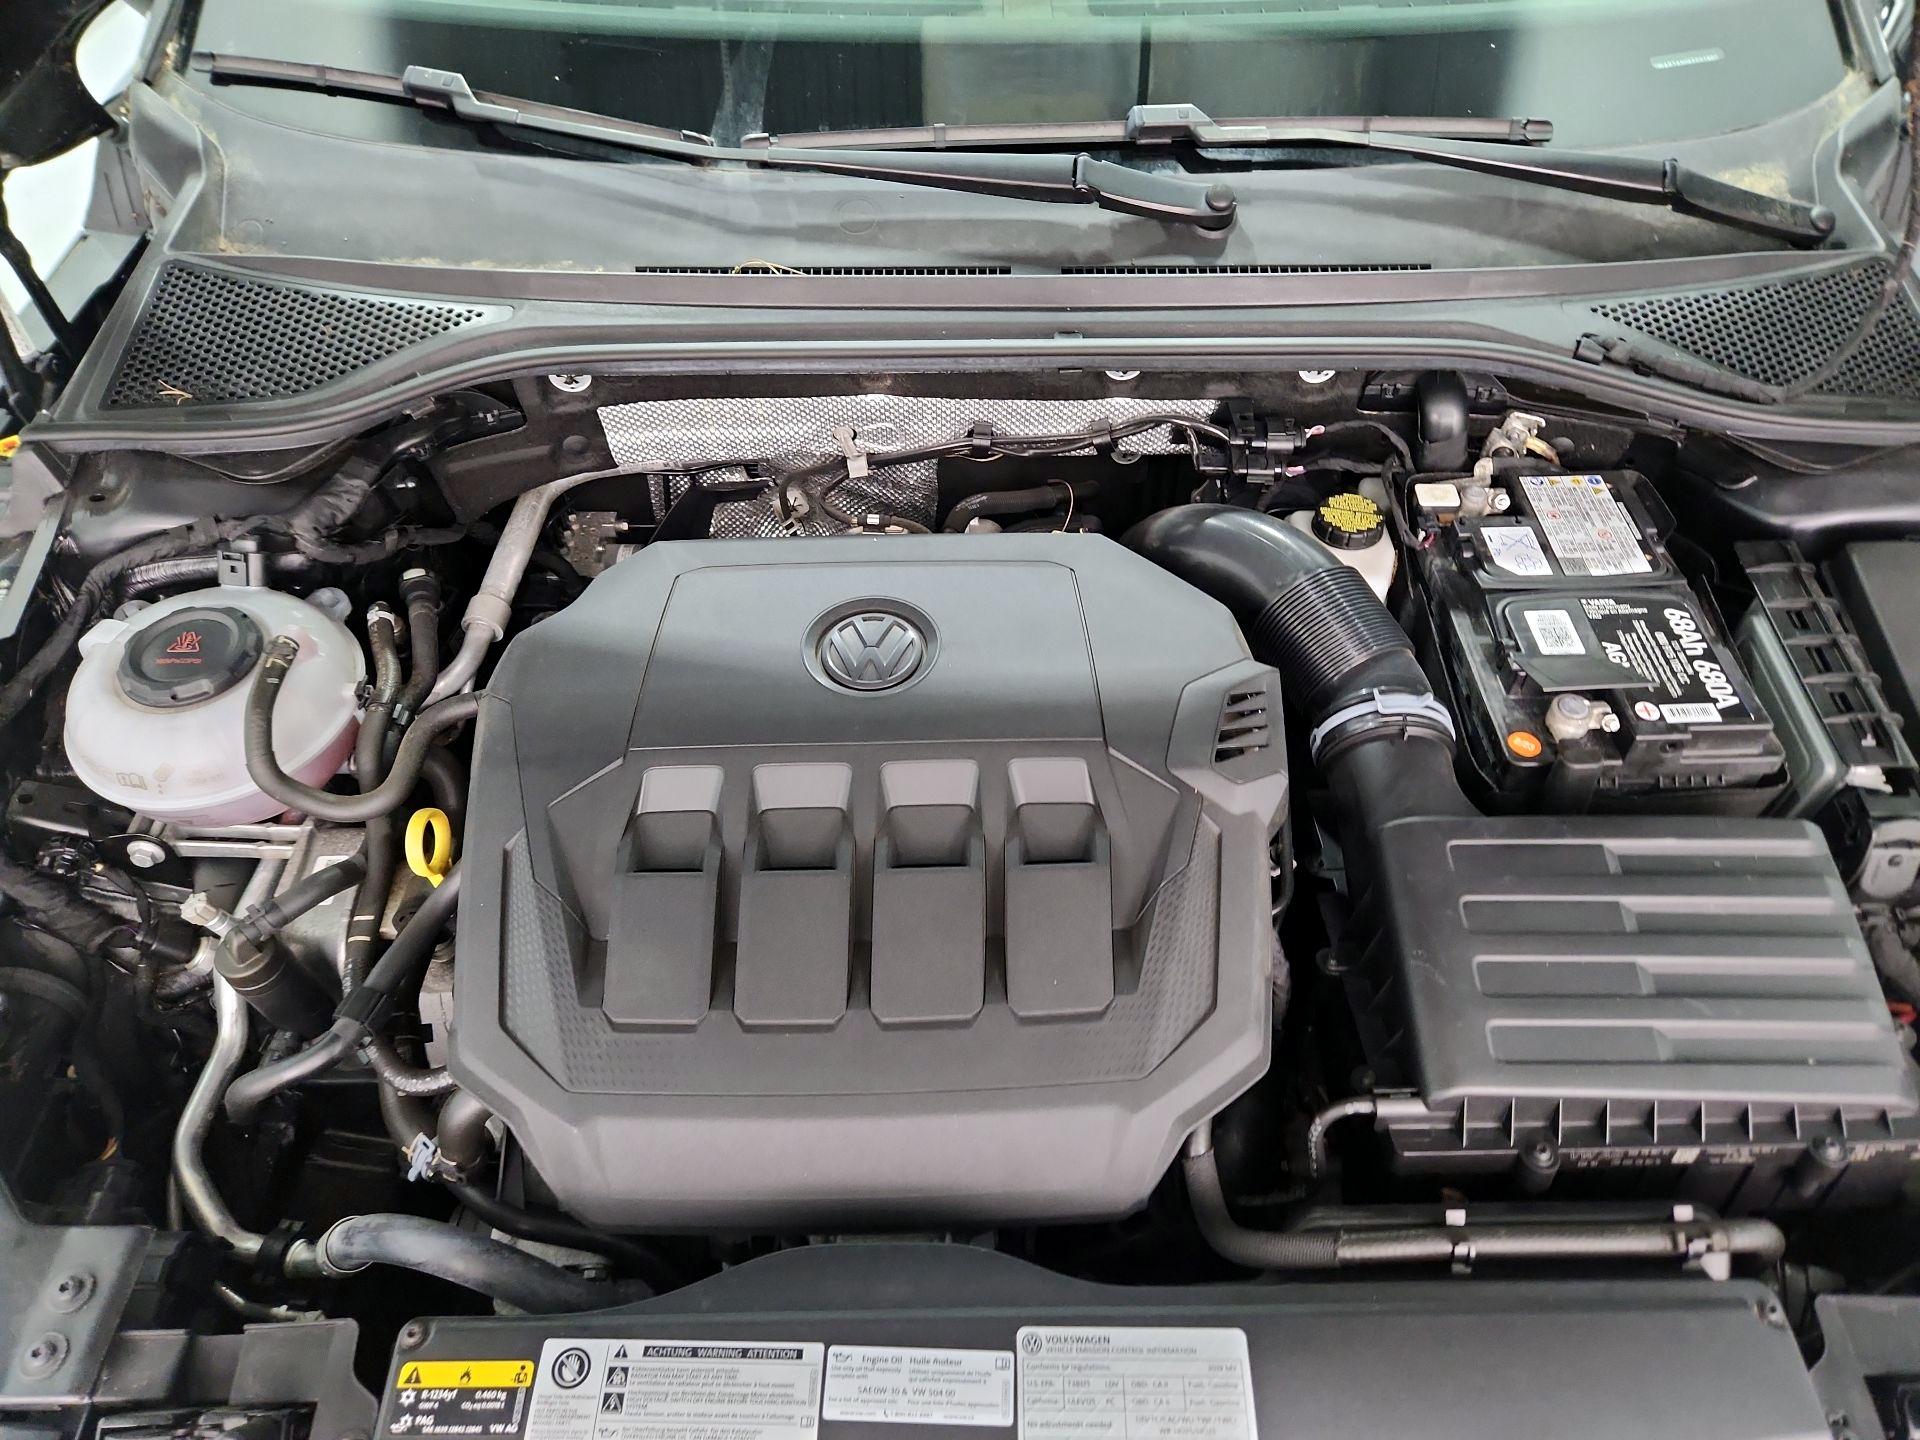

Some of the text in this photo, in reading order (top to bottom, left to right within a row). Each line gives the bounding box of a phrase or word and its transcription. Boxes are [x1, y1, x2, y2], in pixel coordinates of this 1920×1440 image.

[1663, 607, 1708, 657] 68Ah
[1692, 659, 1740, 710] 680A
[1046, 1335, 1111, 1345] VOLKSWAGEN
[646, 1347, 798, 1360] ACHTUNG WARNING ATTENTION
[1146, 1346, 1198, 1355] INFORMATION
[862, 1354, 962, 1366] Engine Oil Huile moteur
[414, 1415, 436, 1426] PAG
[489, 1423, 505, 1434] VW
[505, 1423, 520, 1434] AG
